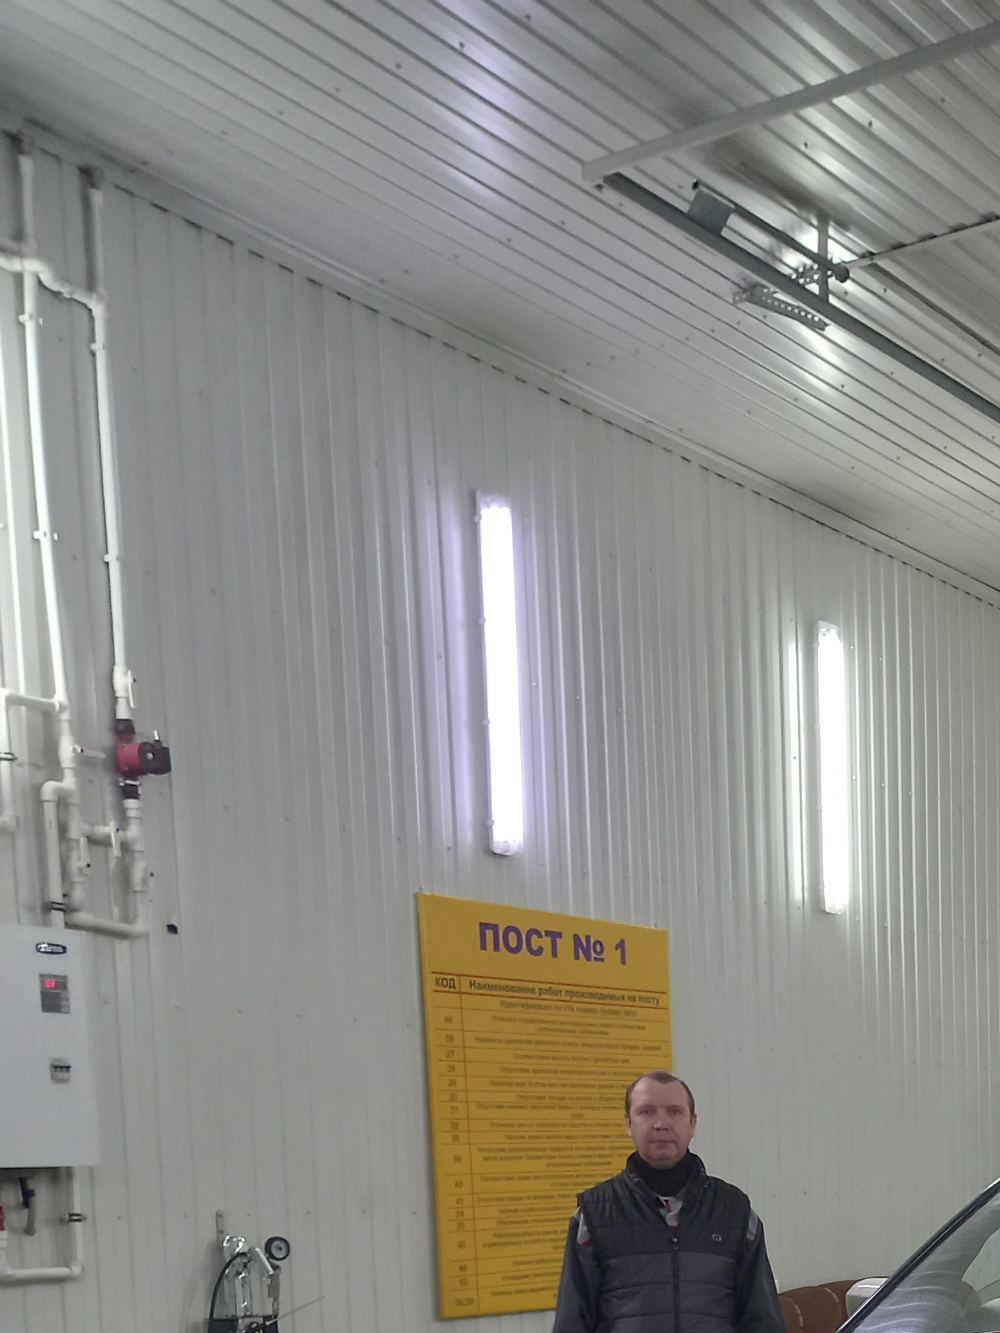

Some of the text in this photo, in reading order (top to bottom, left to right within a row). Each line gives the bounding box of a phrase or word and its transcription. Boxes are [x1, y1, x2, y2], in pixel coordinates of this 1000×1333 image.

[479, 921, 626, 965] ПОСТ № 1
[435, 977, 456, 990] КОД
